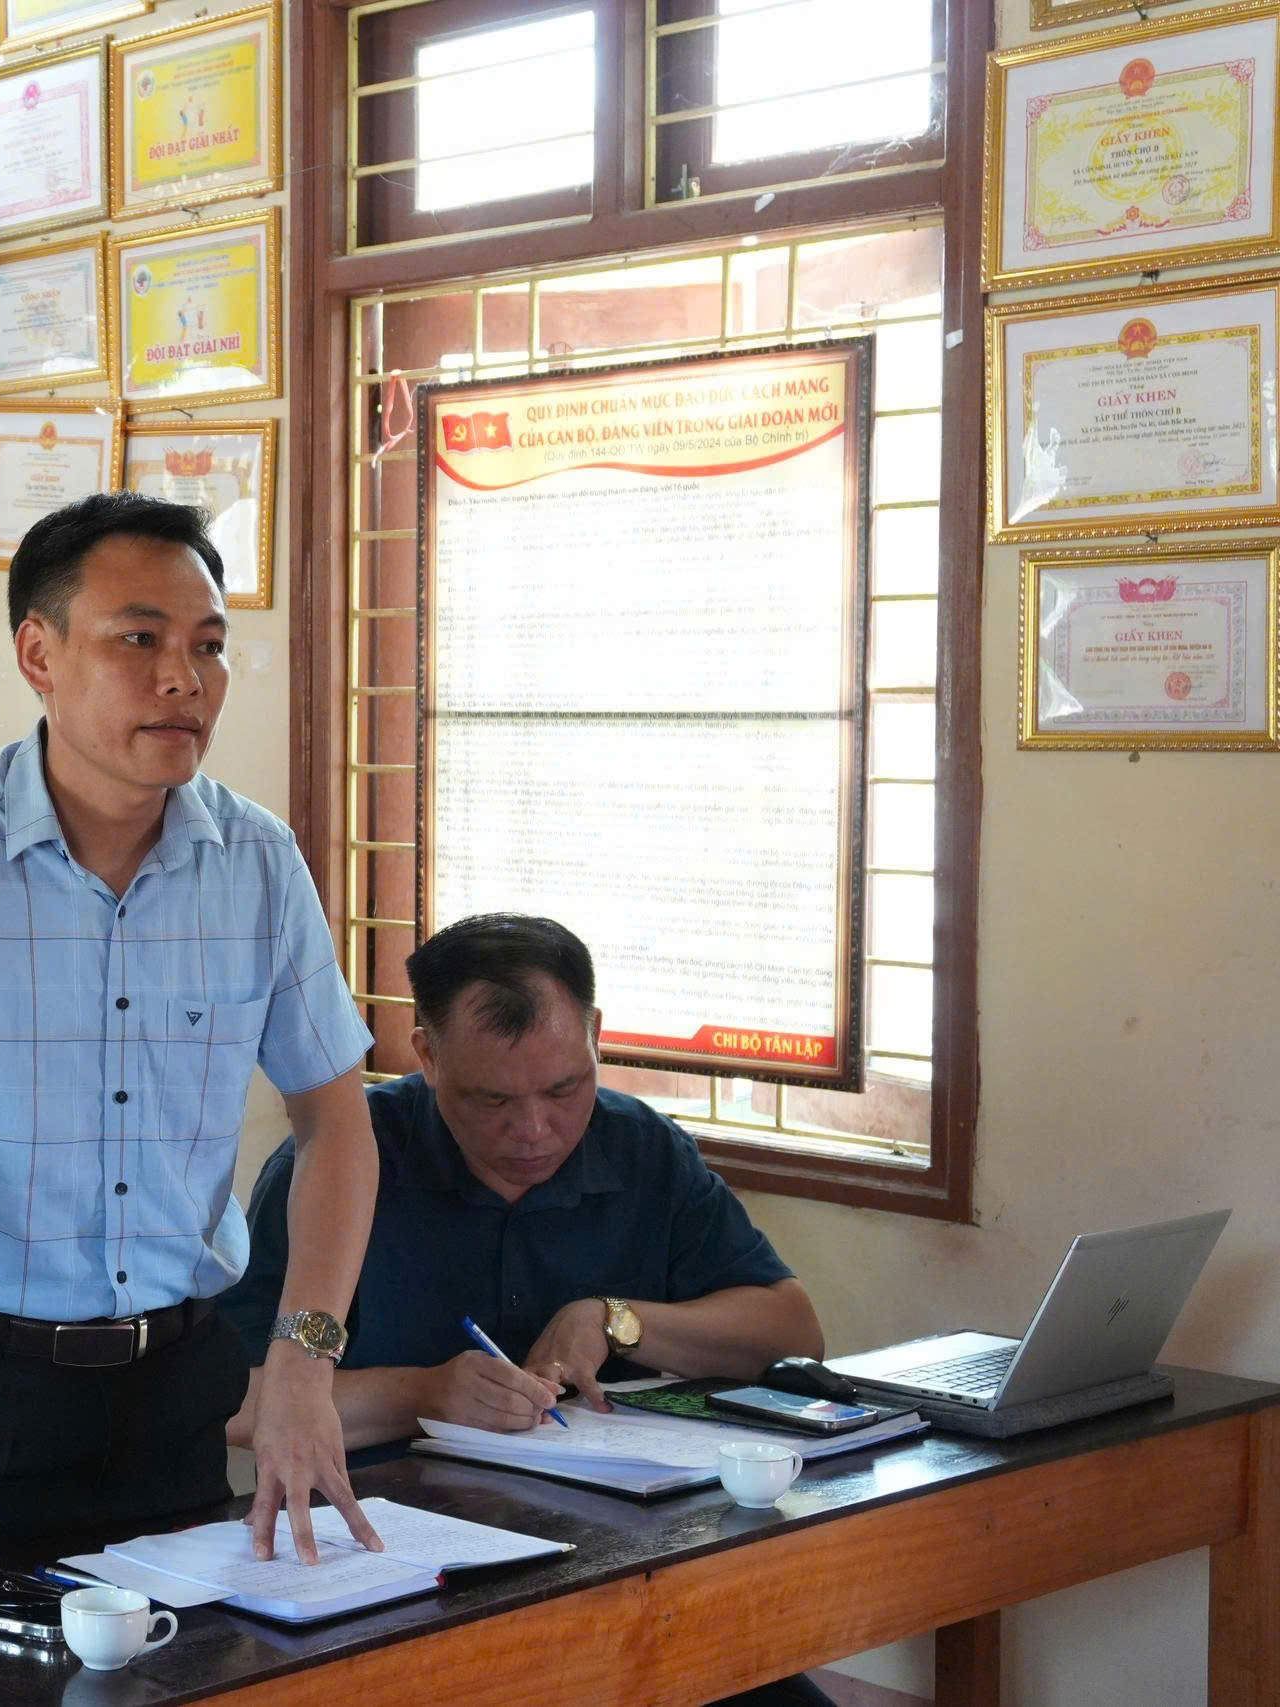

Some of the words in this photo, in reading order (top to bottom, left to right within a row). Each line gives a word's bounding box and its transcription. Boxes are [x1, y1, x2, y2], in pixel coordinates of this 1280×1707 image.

[1134, 127, 1170, 143] KHEN
[146, 343, 165, 363] ĐỘI
[168, 343, 191, 361] ĐẠT
[193, 335, 217, 354] GIẢI
[785, 377, 830, 401] MẠNG
[1136, 388, 1177, 404] KHEN
[678, 415, 725, 434] TRONG
[728, 411, 759, 430] GIAI
[808, 401, 840, 422] MỚI
[724, 435, 742, 448] của
[745, 433, 759, 447] Bộ
[762, 429, 792, 444] Chính
[1148, 630, 1184, 641] KHEN
[713, 1031, 737, 1049] CHI
[741, 1032, 762, 1055] BỘ
[765, 1034, 793, 1054] TÂN
[795, 1036, 824, 1060] LẬP
